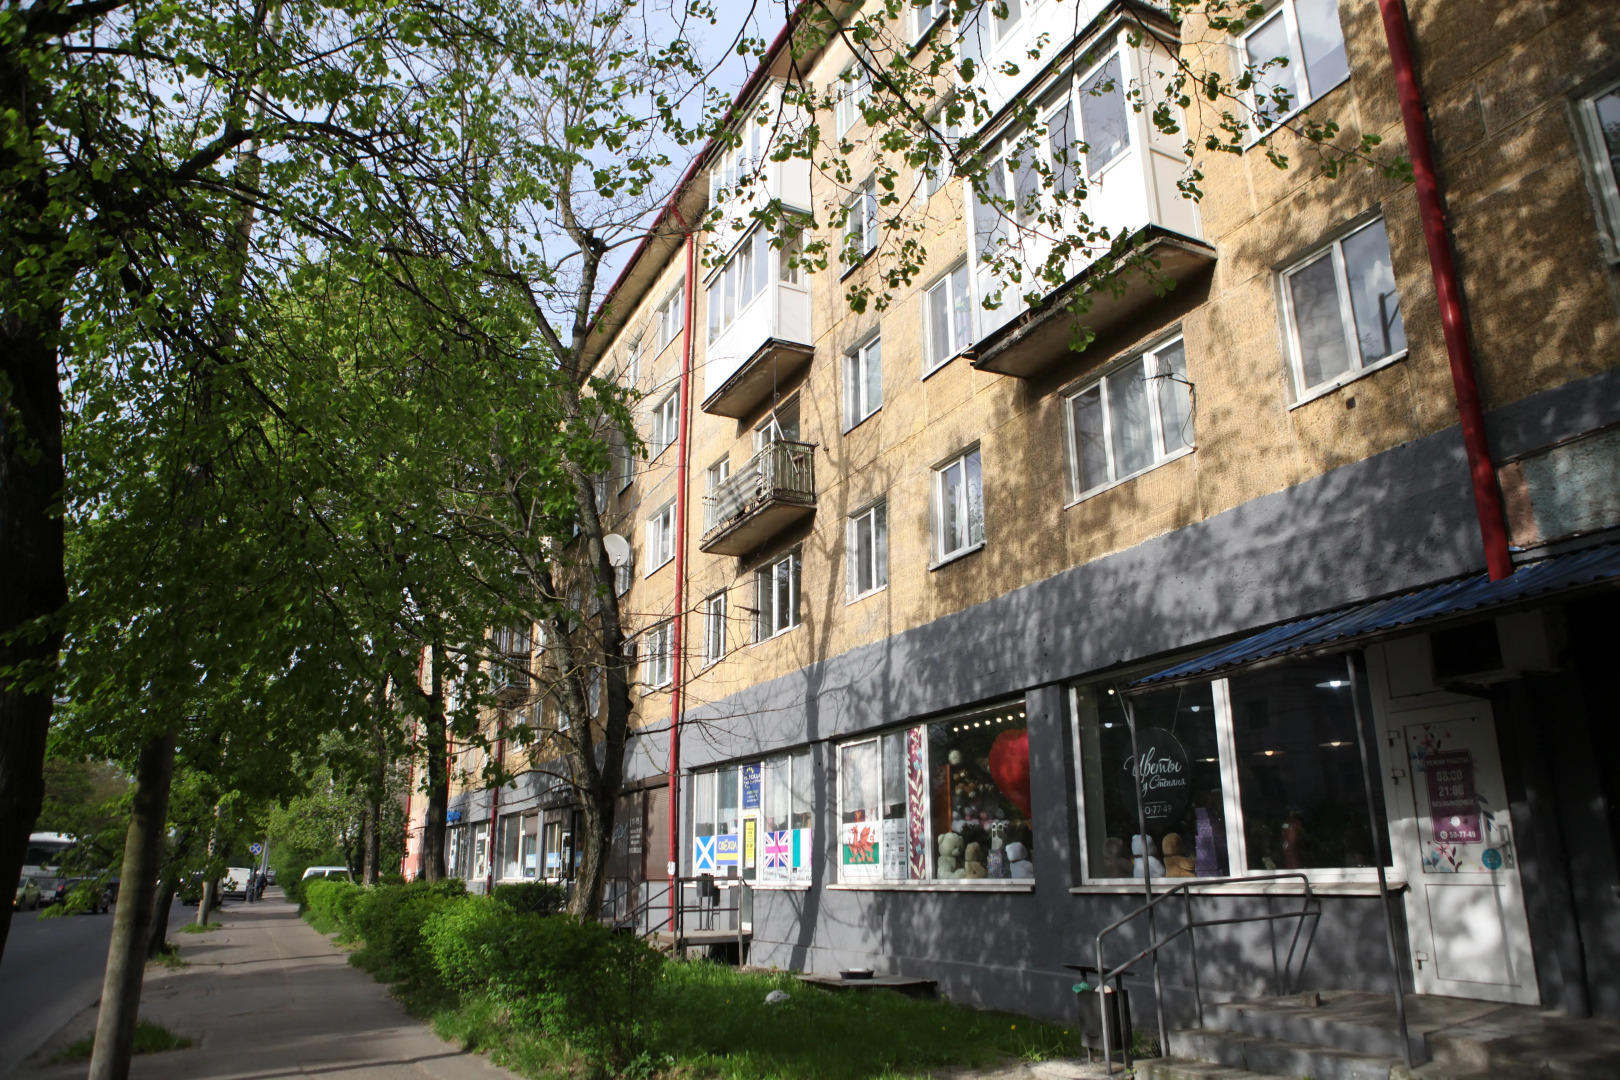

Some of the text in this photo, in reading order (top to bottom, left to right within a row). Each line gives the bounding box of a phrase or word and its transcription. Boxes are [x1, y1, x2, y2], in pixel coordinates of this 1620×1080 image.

[1124, 747, 1182, 782] Цветы
[1149, 775, 1186, 789] Степана
[1436, 769, 1463, 782] 08:00
[1438, 784, 1465, 797] 21:00
